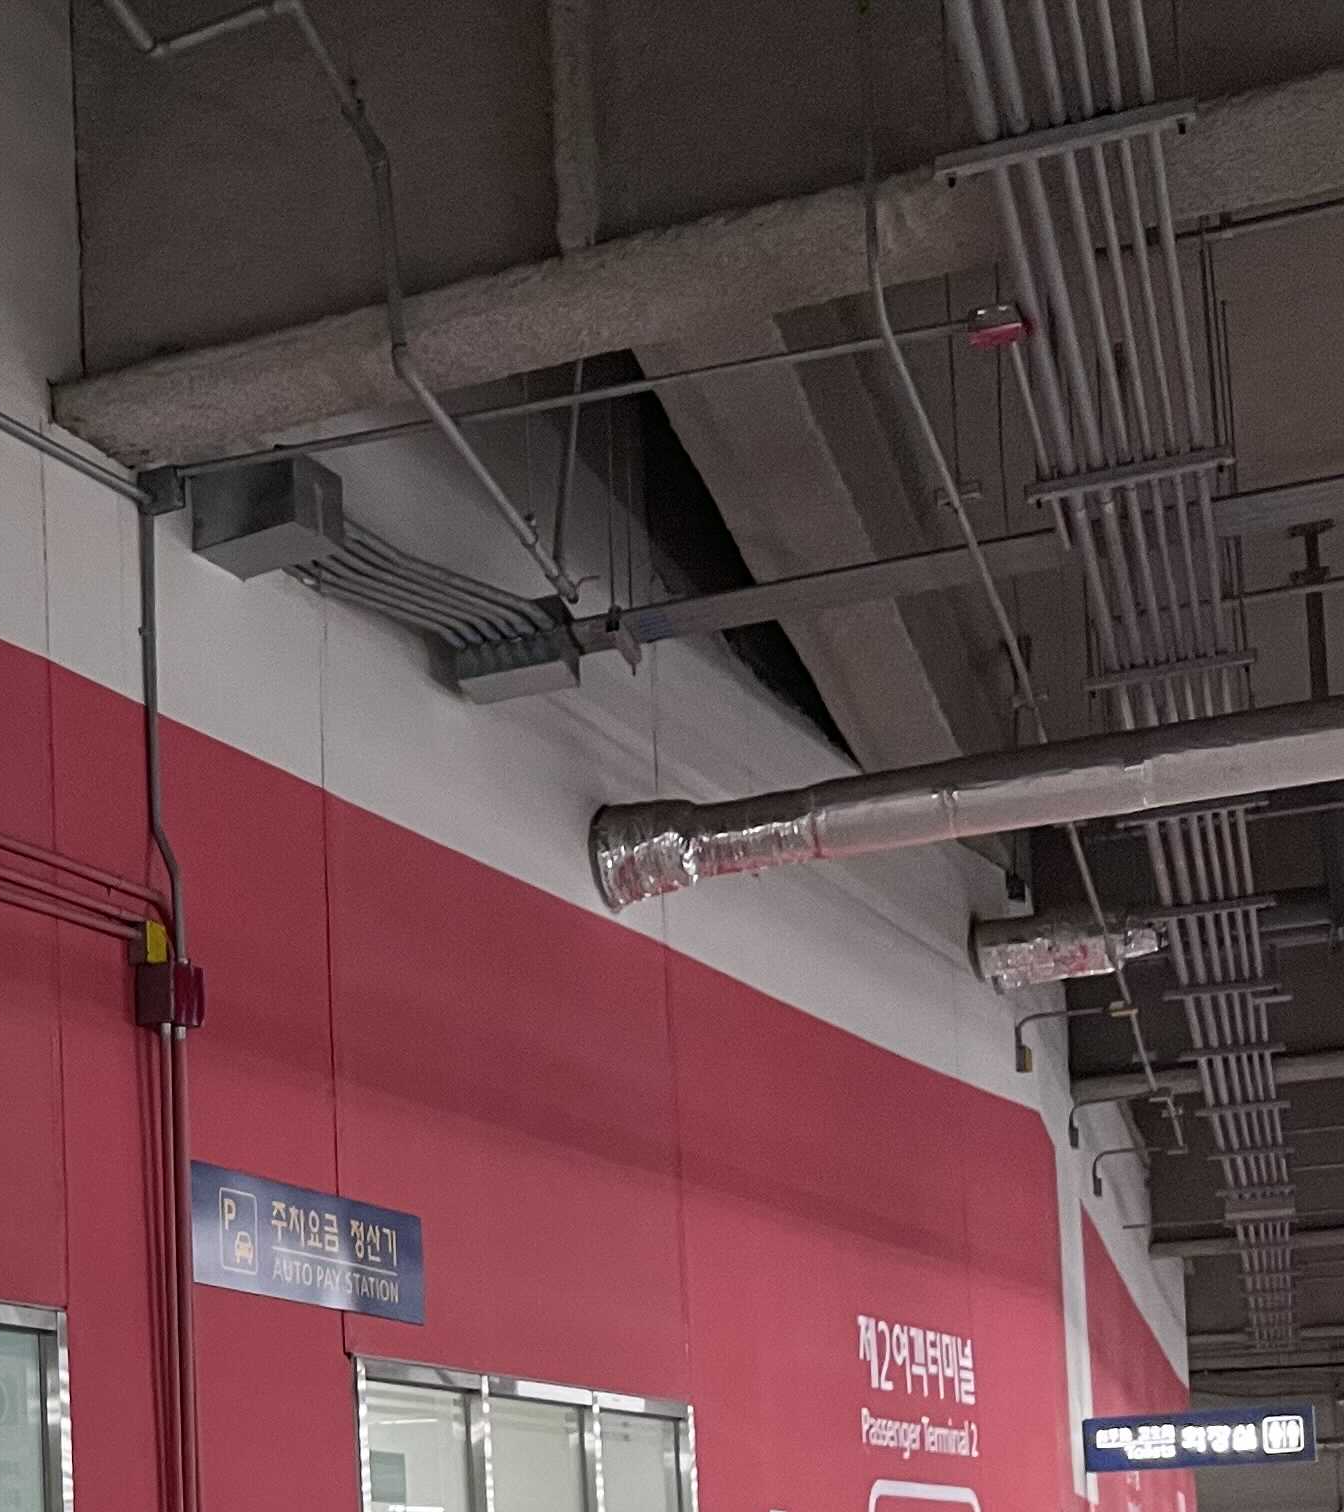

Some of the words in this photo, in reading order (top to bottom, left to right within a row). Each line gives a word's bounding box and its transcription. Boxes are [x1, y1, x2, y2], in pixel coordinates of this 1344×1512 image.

[271, 1200, 339, 1252] 주차요금
[350, 1219, 398, 1267] 정산기
[273, 1259, 313, 1287] AUTO
[317, 1267, 340, 1291] PAY
[345, 1275, 399, 1304] STATION
[857, 1314, 976, 1405] 제2여객터미널
[861, 1407, 921, 1459] Passenger
[921, 1416, 970, 1456] Terminal
[971, 1421, 979, 1457] 2
